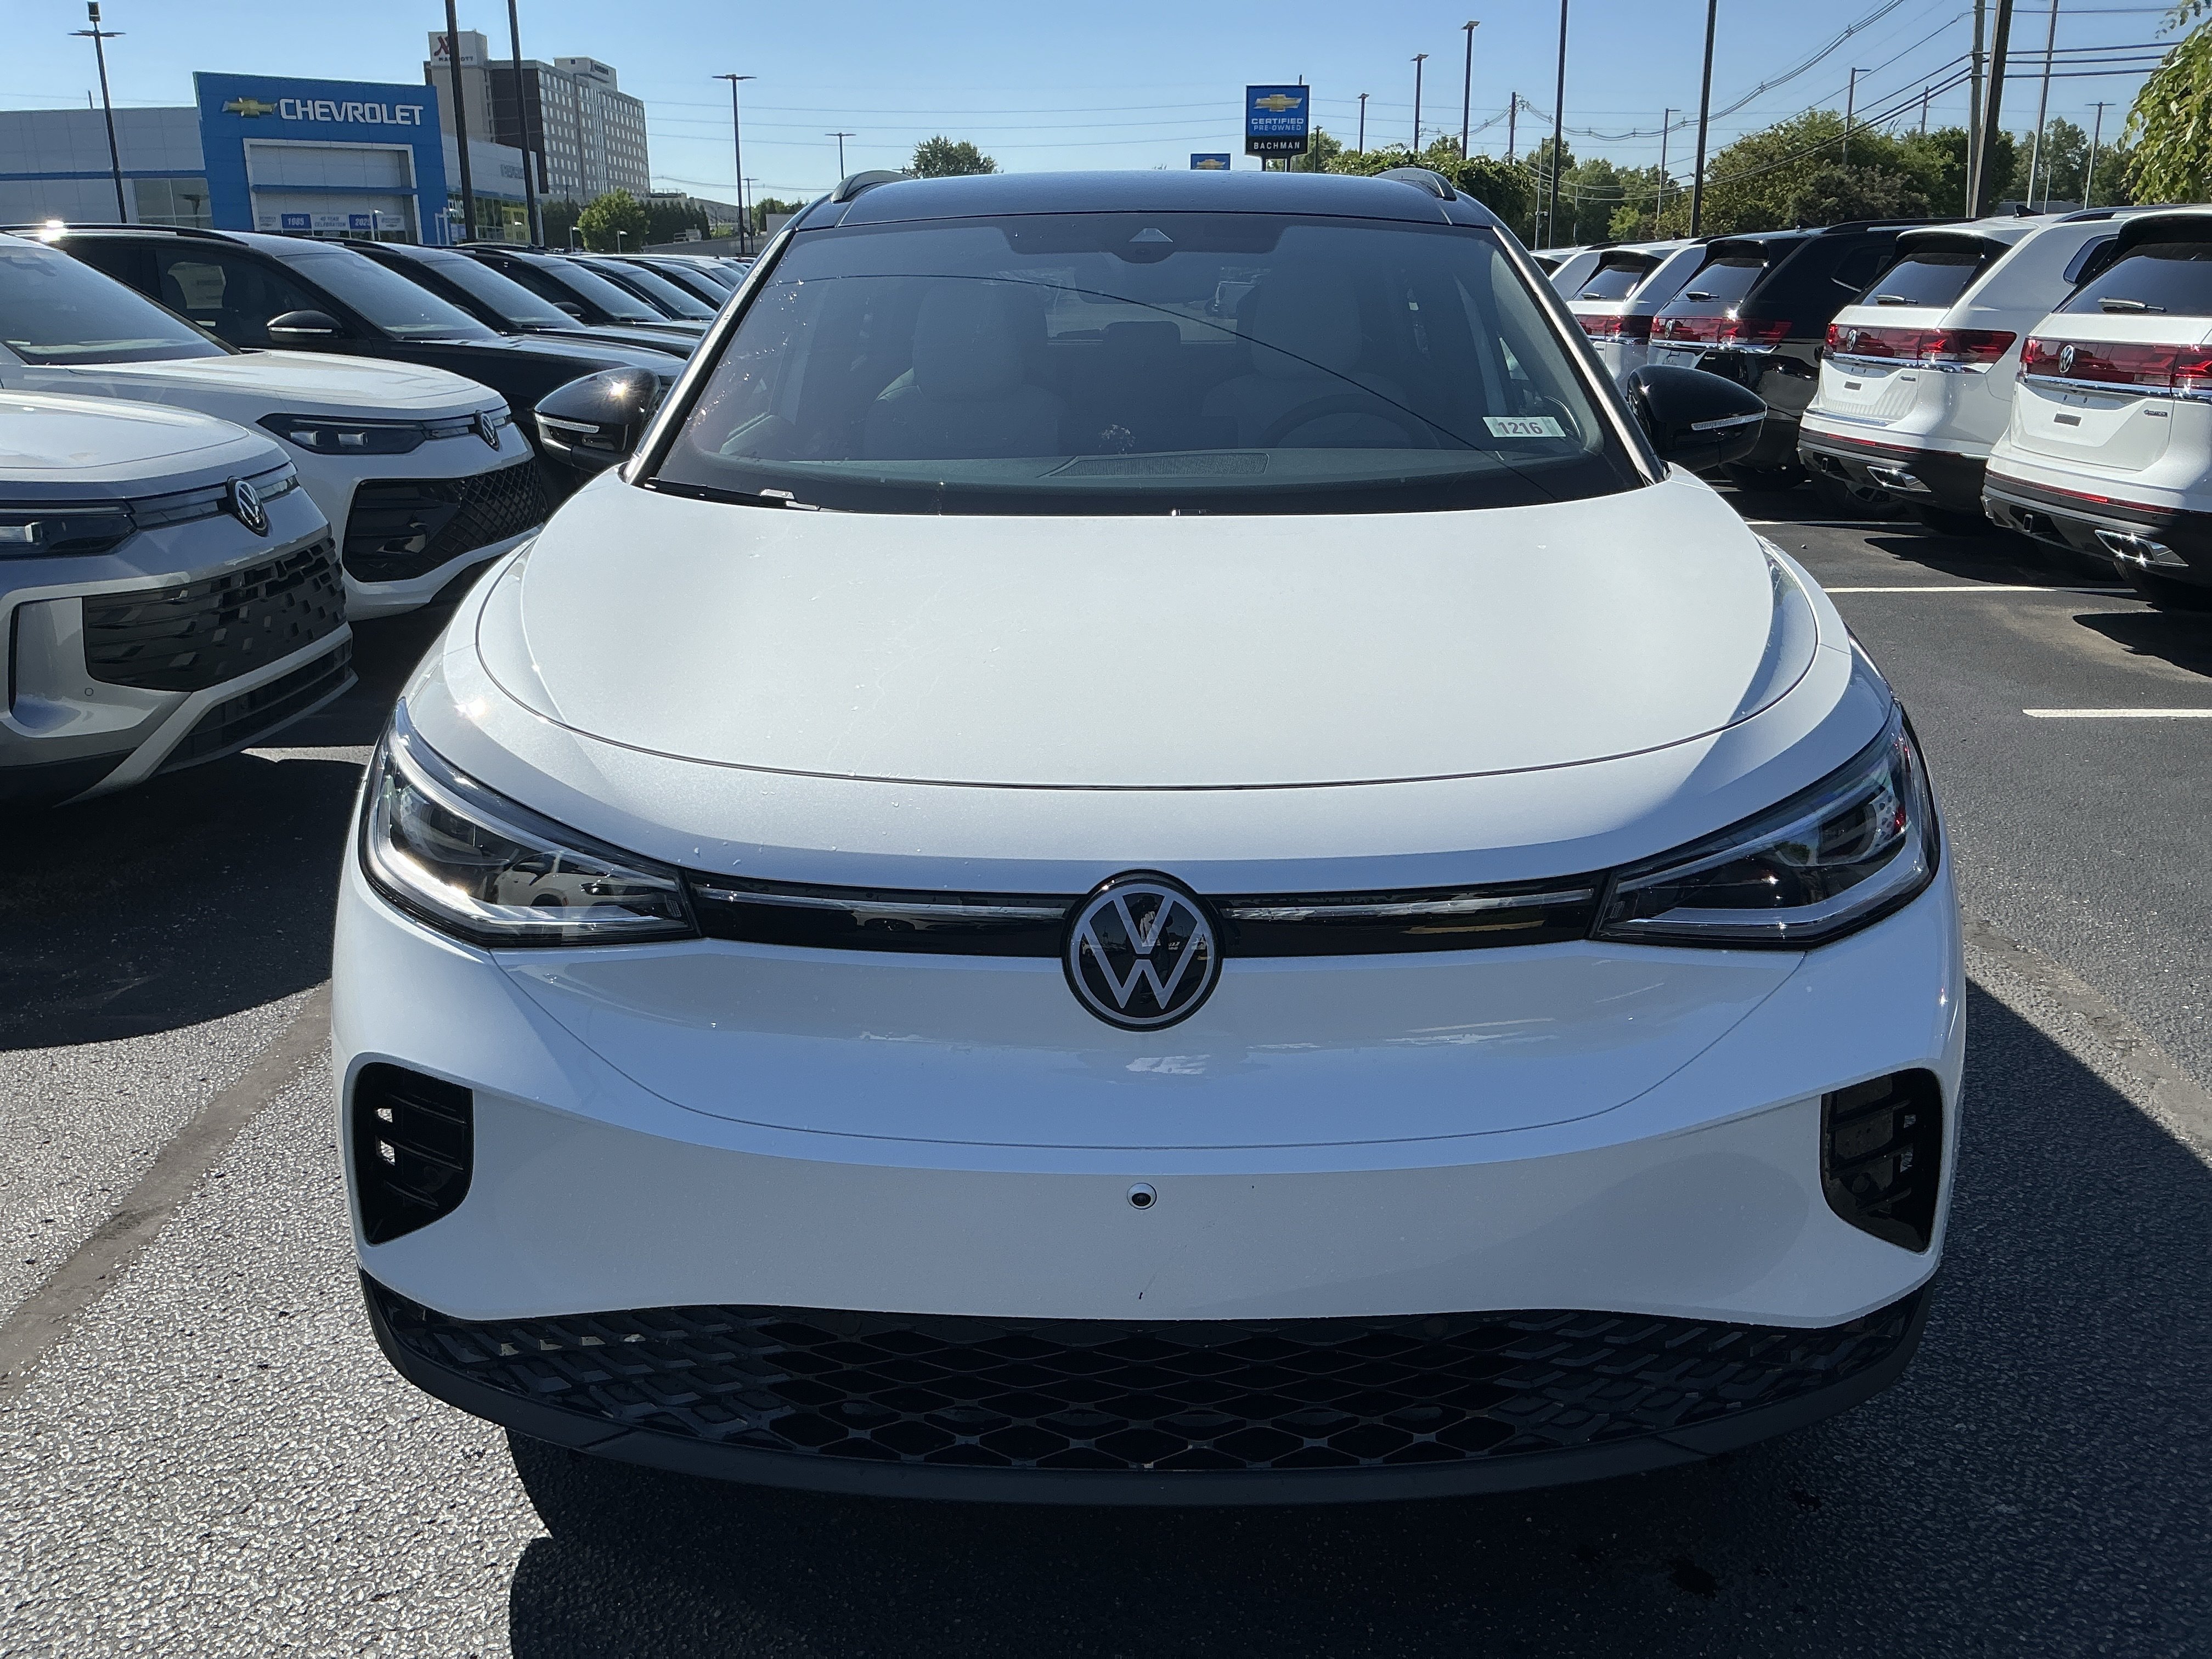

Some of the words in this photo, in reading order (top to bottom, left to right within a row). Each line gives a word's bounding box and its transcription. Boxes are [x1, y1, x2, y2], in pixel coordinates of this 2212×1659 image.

[279, 98, 424, 126] CHEVROLET
[1498, 422, 1543, 435] 1216
[1071, 884, 1214, 1024] VW
